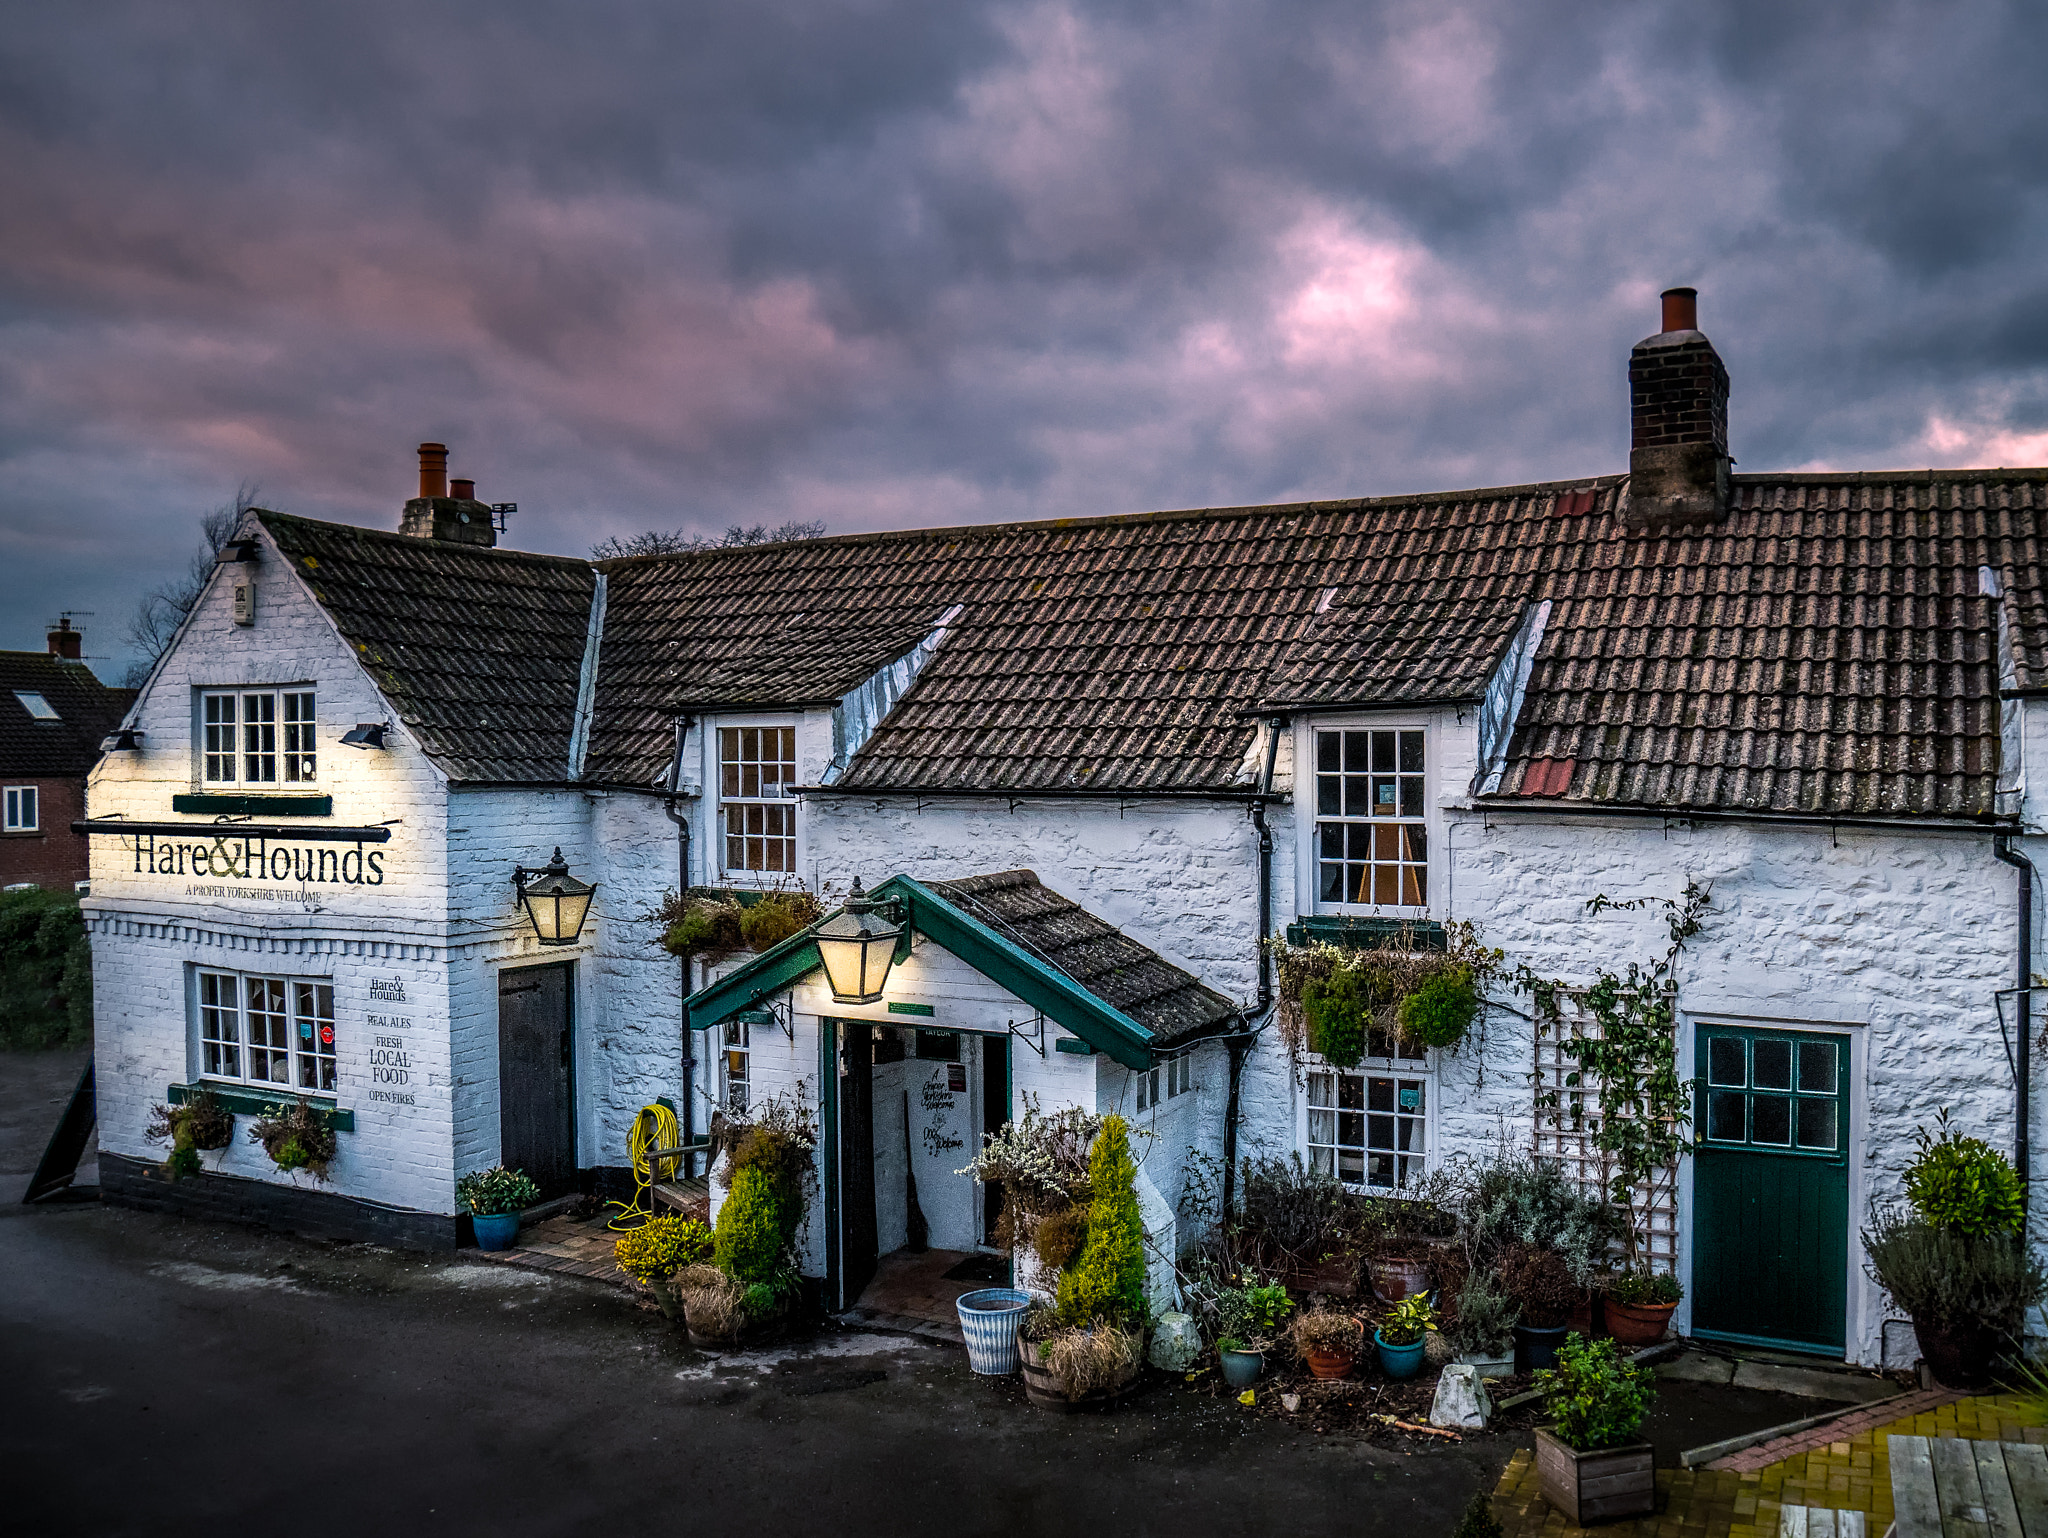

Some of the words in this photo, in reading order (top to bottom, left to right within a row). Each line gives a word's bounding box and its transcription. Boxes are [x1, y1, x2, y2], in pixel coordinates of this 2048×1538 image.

[185, 884, 192, 895] A
[193, 885, 225, 898] PROPER
[226, 886, 274, 901] YORKSHIRE
[276, 889, 321, 903] WELCOME
[371, 976, 404, 992] Hare&
[370, 987, 406, 1001] Hounds
[367, 1015, 390, 1027] REAL
[390, 1017, 411, 1029] ALES
[376, 1036, 402, 1049] FRESH
[370, 1049, 411, 1067] LOCAL
[373, 1067, 408, 1085] FOOD
[932, 1068, 940, 1081] A
[369, 1090, 391, 1102] OPEN
[392, 1092, 415, 1105] FIRES
